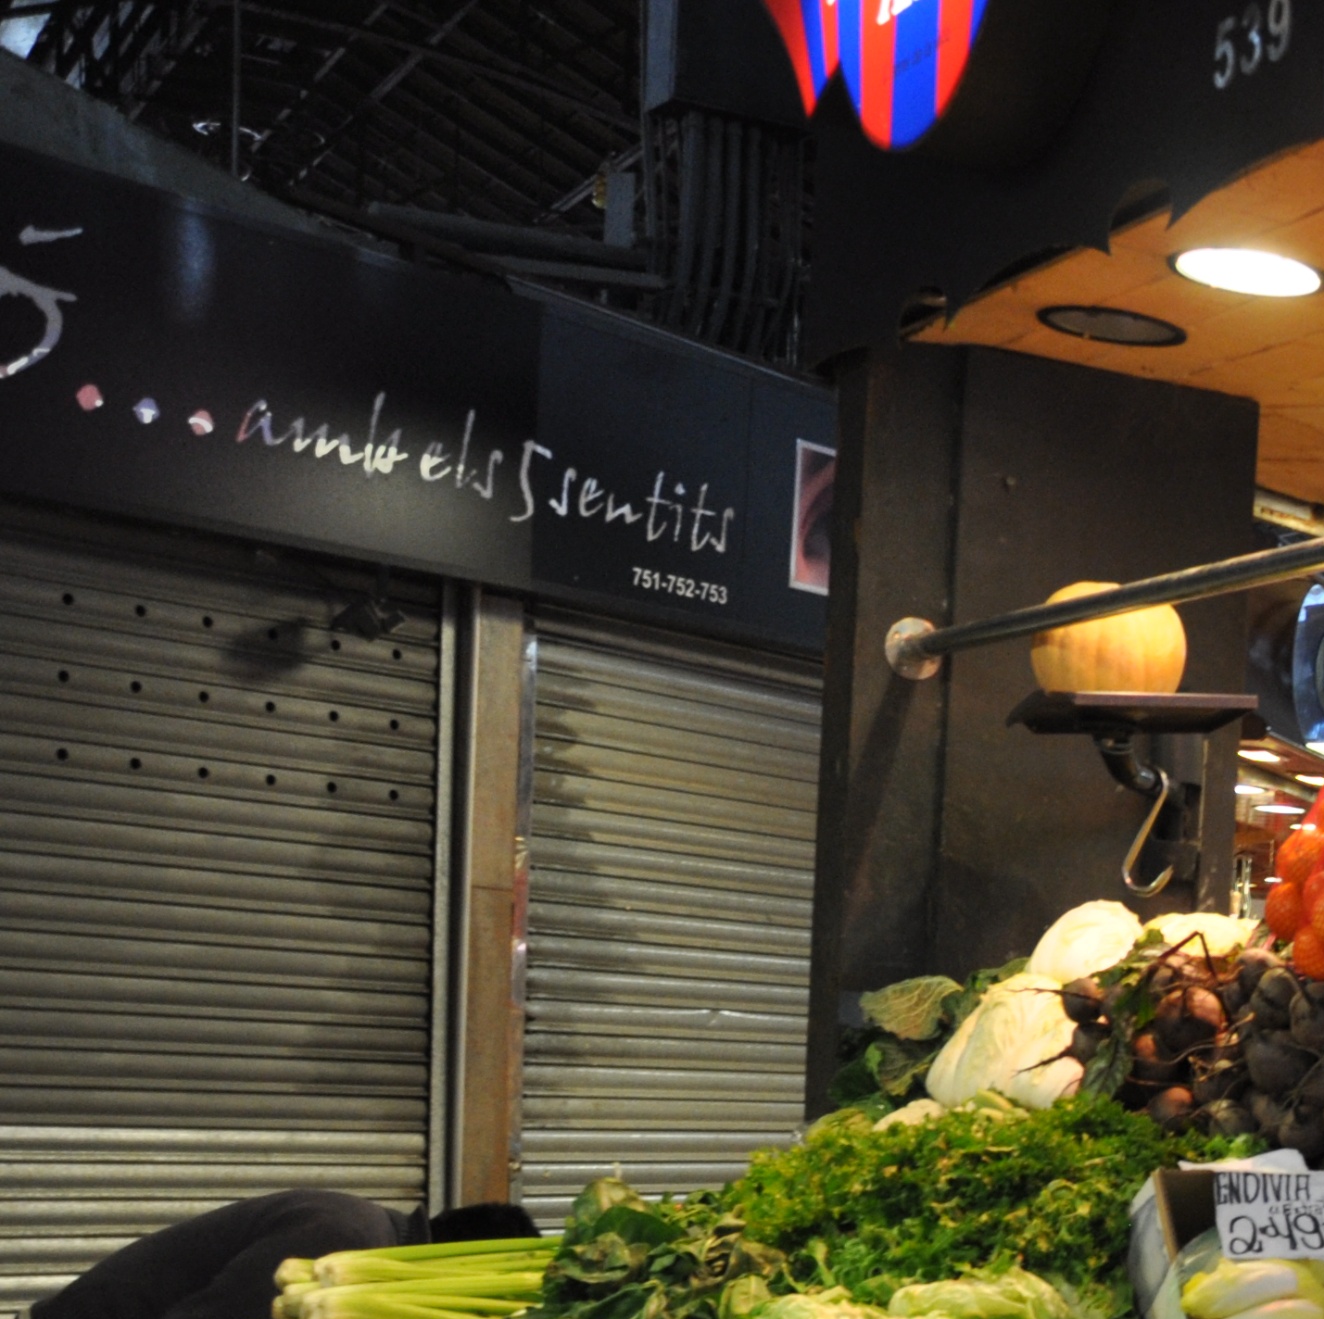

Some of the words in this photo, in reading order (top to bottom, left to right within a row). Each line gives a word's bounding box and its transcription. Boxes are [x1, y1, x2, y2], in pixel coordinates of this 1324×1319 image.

[1212, 0, 1292, 90] 539
[630, 565, 729, 605] 751-752-753
[1215, 1171, 1311, 1206] ENDIVIA
